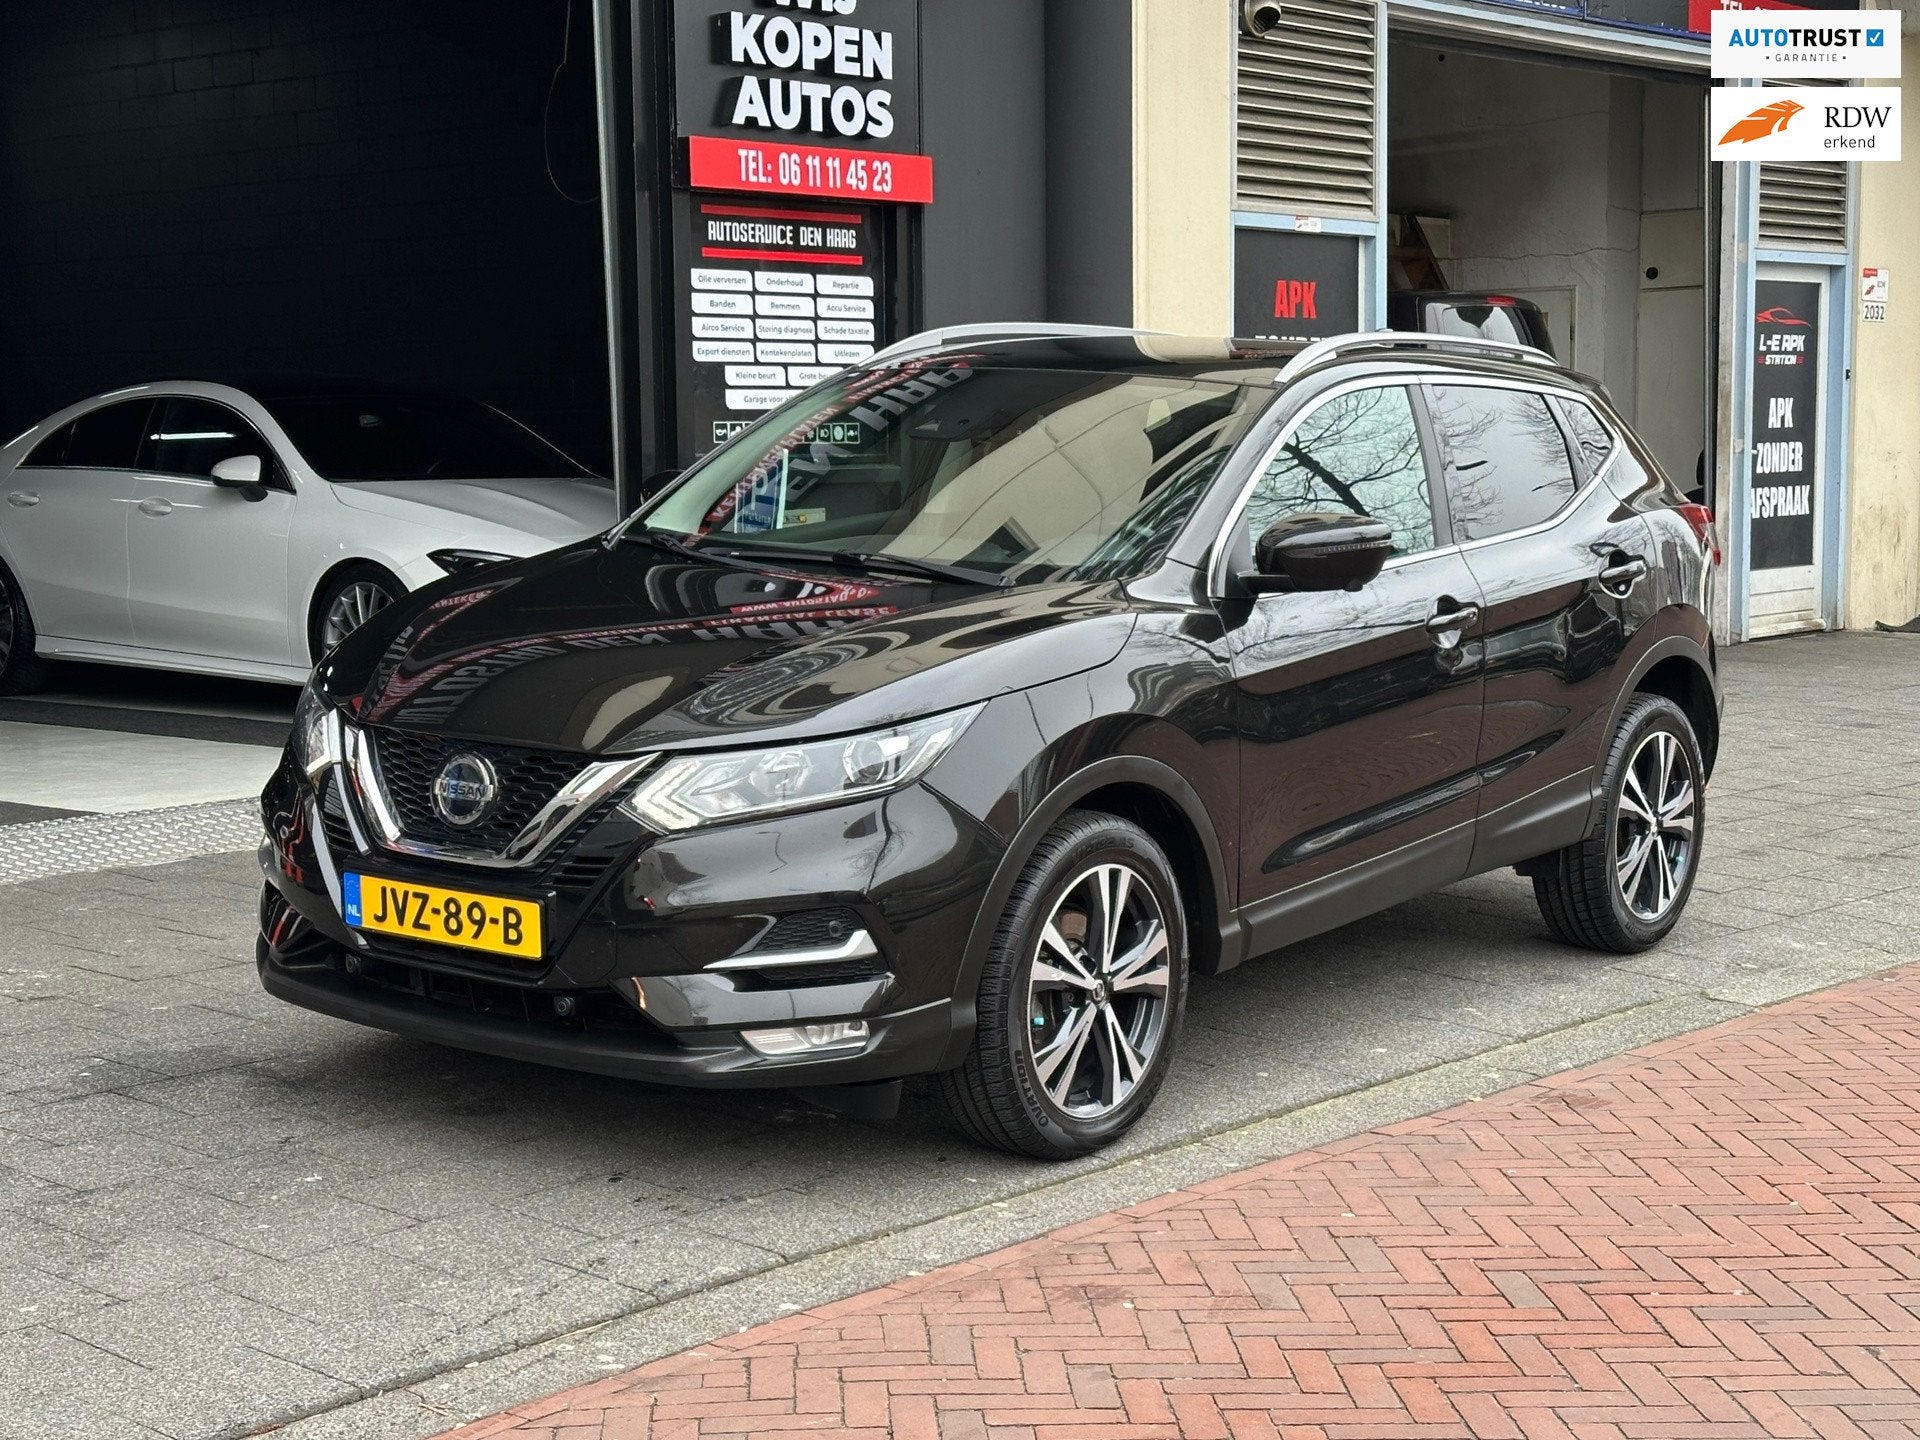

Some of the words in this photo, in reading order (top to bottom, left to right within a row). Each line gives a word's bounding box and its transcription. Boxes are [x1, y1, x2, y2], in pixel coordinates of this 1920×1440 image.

[730, 11, 893, 80] KOPEN
[731, 75, 894, 138] AUTOS
[737, 149, 772, 184] TEL:
[778, 152, 800, 187] 06
[805, 155, 821, 187] 11
[825, 157, 841, 189] 11
[845, 159, 868, 191] 45
[872, 161, 892, 193] 23
[800, 226, 823, 247] DEN
[826, 228, 857, 249] HAAG
[713, 276, 746, 284] verversen
[766, 278, 804, 287] Onderhoud
[710, 299, 736, 308] Banden
[1274, 279, 1317, 319] APK
[827, 304, 842, 312] Accu
[843, 304, 866, 313] Service
[1864, 304, 1885, 320] 2032
[701, 324, 719, 332] Airco
[720, 324, 745, 332] Service
[758, 325, 782, 335] Storing
[824, 326, 847, 334] Schade
[1759, 334, 1781, 352] L-E
[1781, 334, 1806, 352] APK
[697, 347, 720, 357] Export
[720, 347, 751, 356] diensten
[1765, 354, 1797, 365] STATION
[735, 371, 757, 379] Kleine
[757, 371, 776, 379] beurt
[743, 395, 767, 404] Garage
[1768, 397, 1794, 429] APK
[1756, 441, 1803, 474] ZONDER
[438, 780, 488, 799] NISSAN
[347, 903, 361, 917] NL
[373, 885, 523, 946] JVZ-89-B
